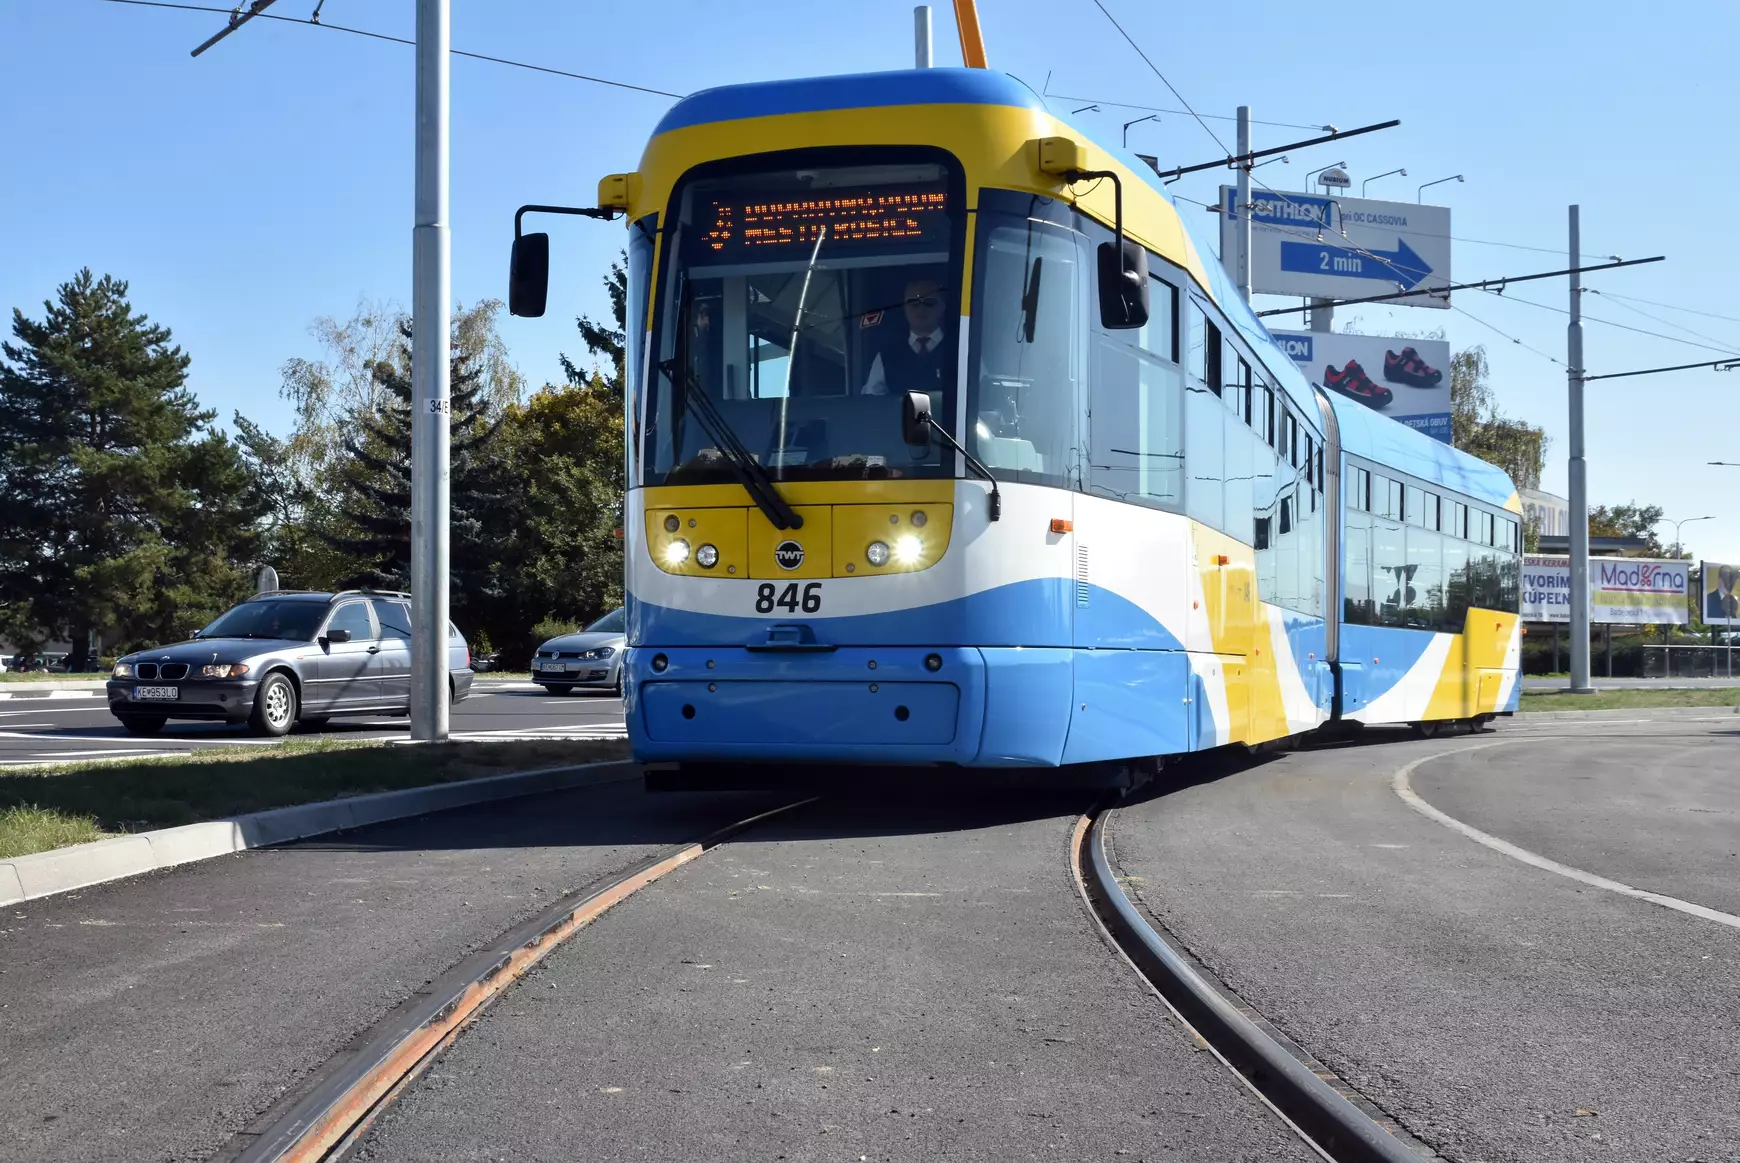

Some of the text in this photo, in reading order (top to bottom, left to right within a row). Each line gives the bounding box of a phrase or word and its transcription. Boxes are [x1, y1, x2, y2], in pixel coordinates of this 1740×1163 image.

[1366, 213, 1408, 226] CASSOVIA
[1320, 251, 1362, 272] 2 min
[755, 582, 823, 614] 846
